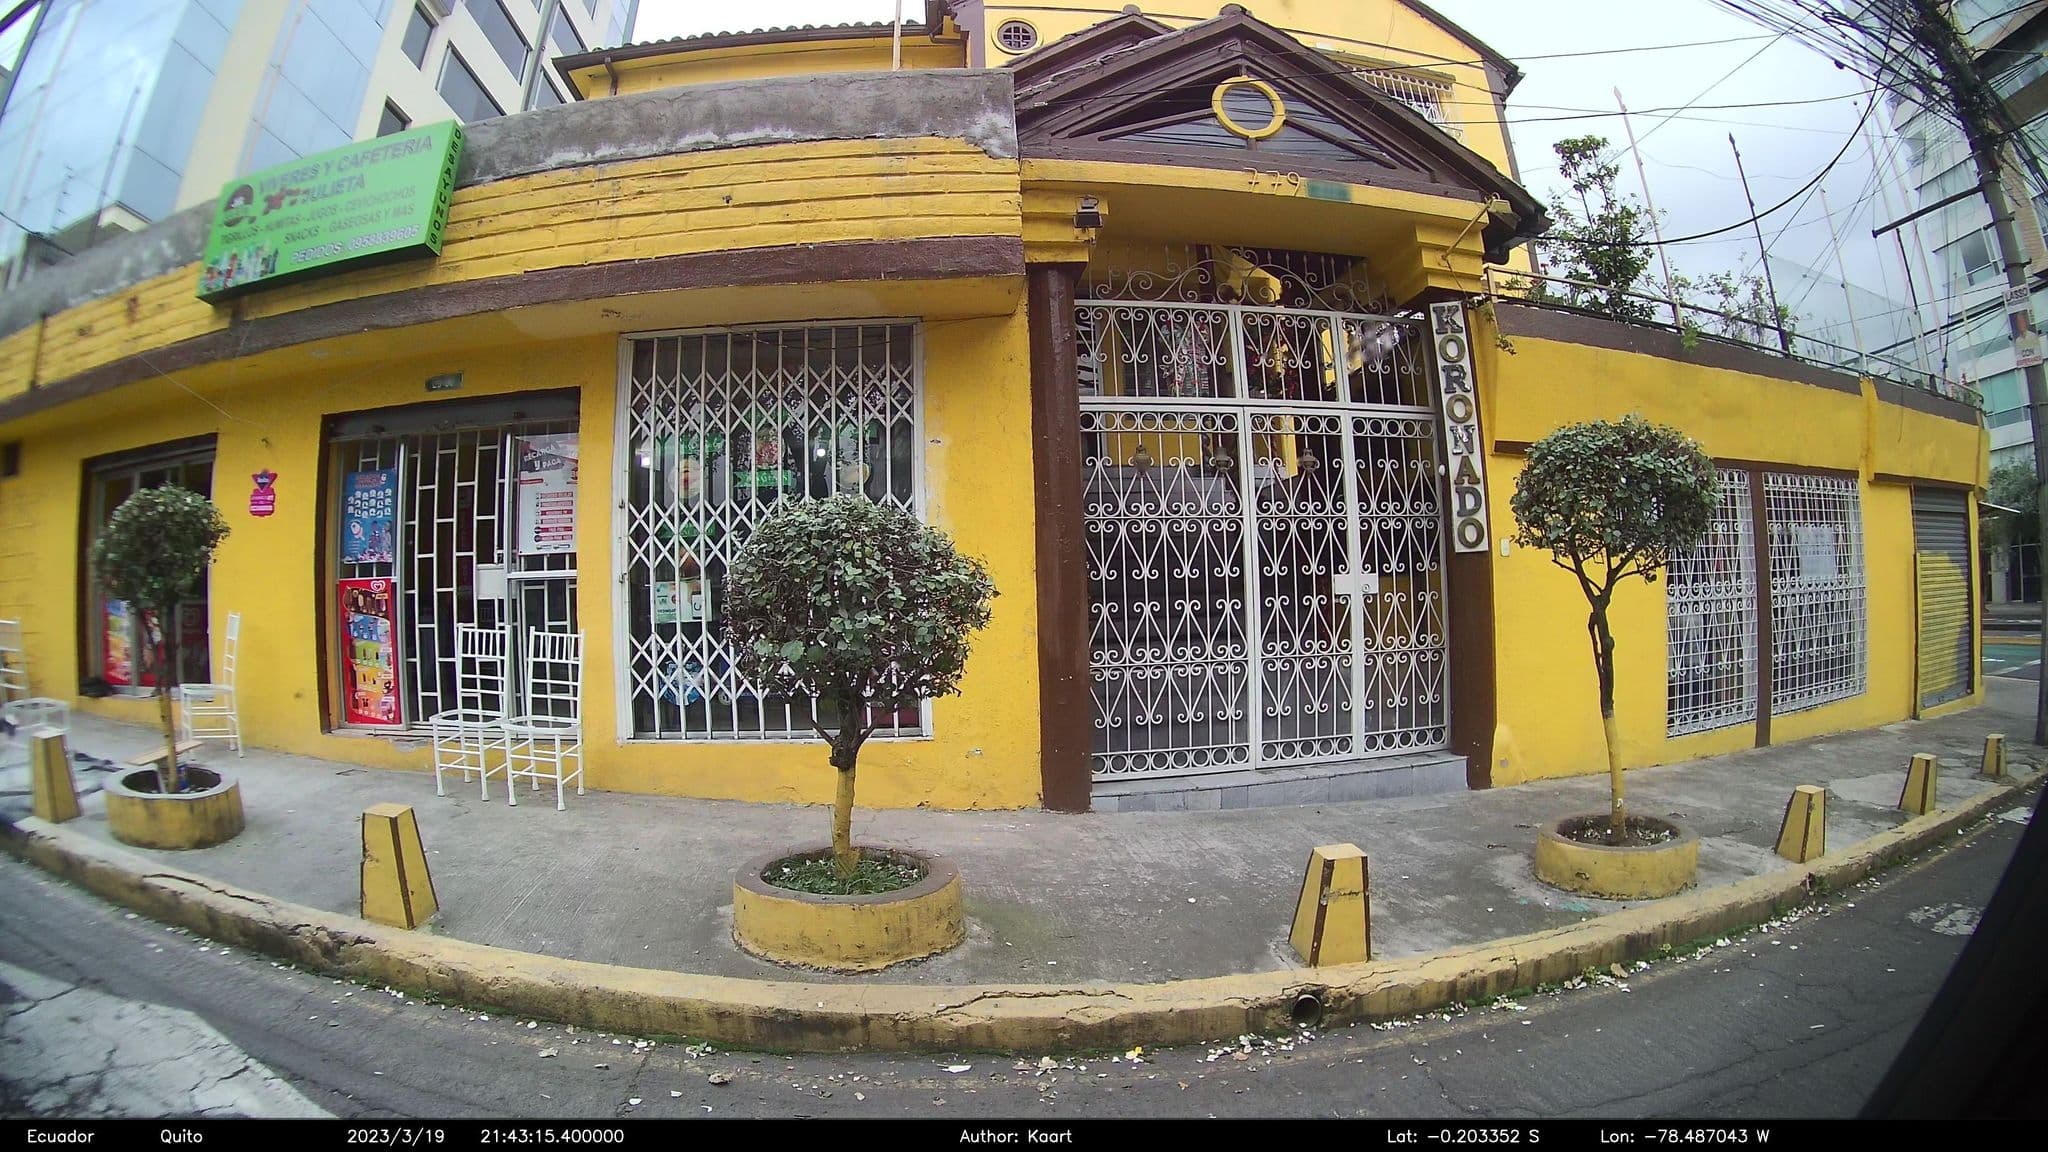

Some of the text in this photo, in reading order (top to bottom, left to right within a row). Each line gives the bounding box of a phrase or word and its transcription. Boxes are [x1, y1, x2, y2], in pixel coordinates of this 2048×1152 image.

[321, 161, 333, 176] Y
[337, 136, 432, 172] CAFETERIA
[430, 129, 461, 245] DESAYUNOS
[1243, 167, 1300, 197] 779
[2005, 288, 2028, 302] LASSO
[1433, 304, 1485, 549] KORONADO
